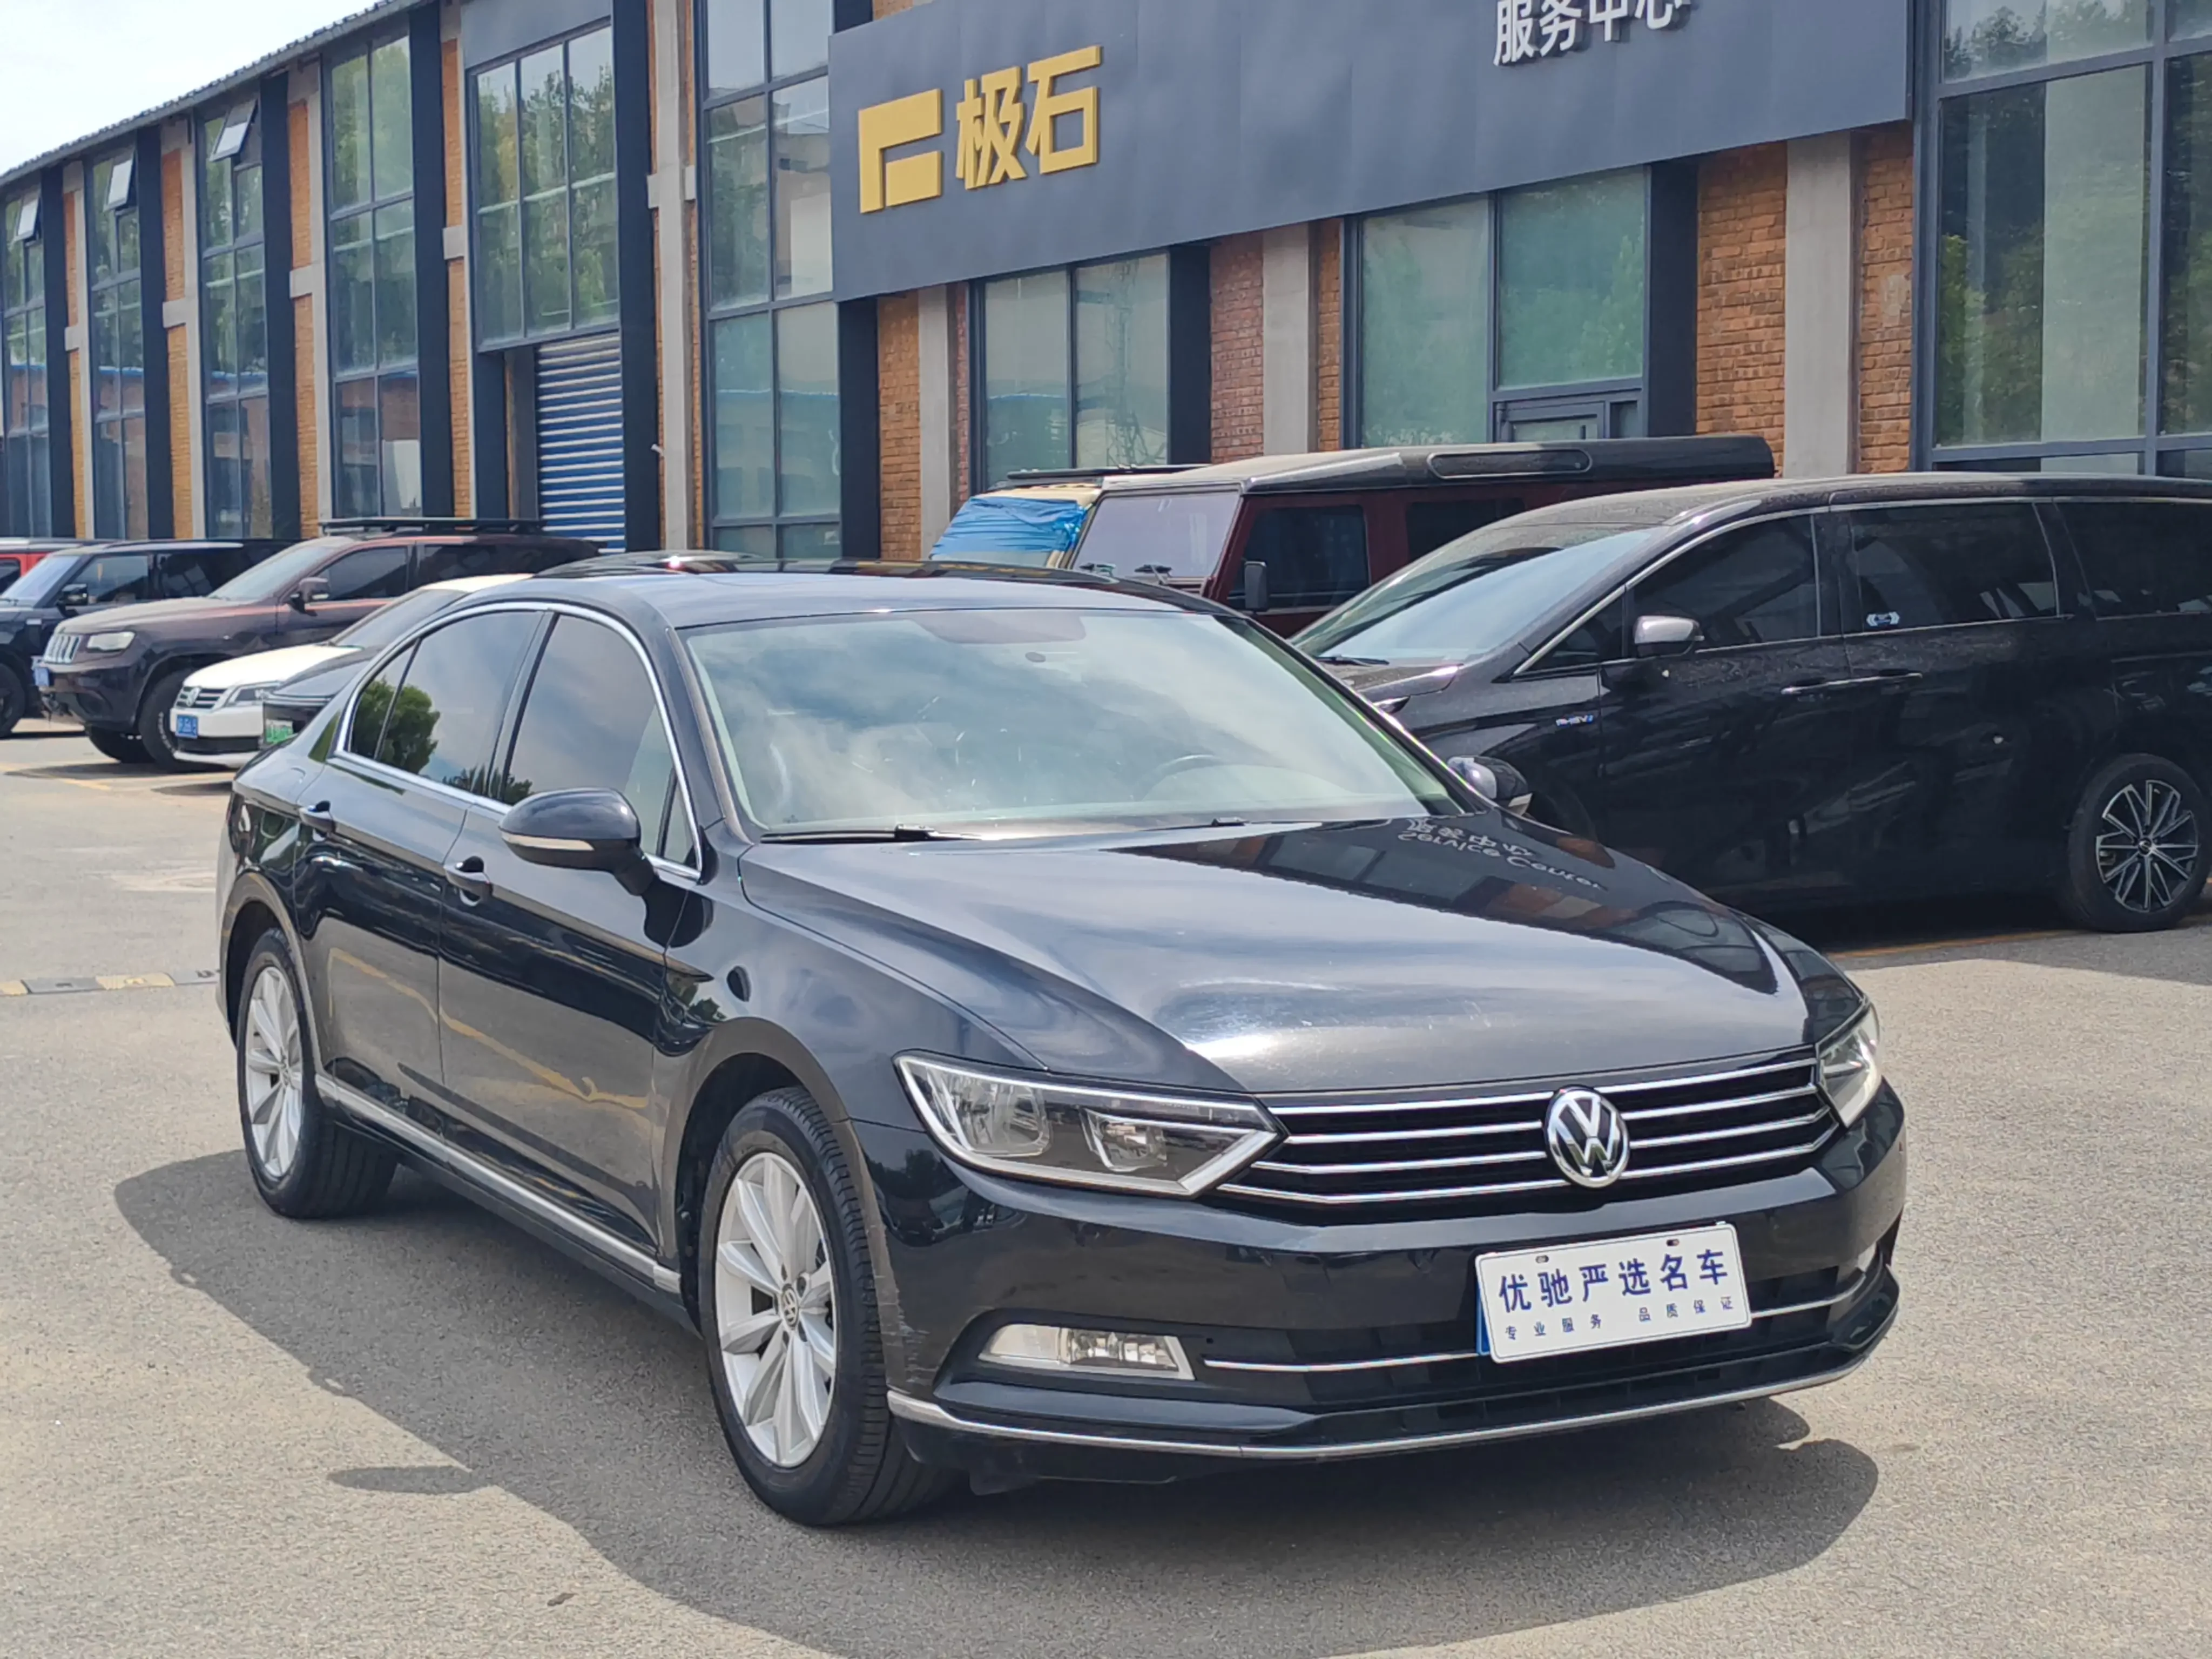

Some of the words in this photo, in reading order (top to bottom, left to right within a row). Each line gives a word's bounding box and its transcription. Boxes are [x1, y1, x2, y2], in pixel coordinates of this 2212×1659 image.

[956, 45, 1103, 190] 极石
[1499, 1249, 1728, 1313] 优驰严选名车
[1505, 1313, 1602, 1341] 专业服务
[1638, 1296, 1735, 1323] 品质保证
